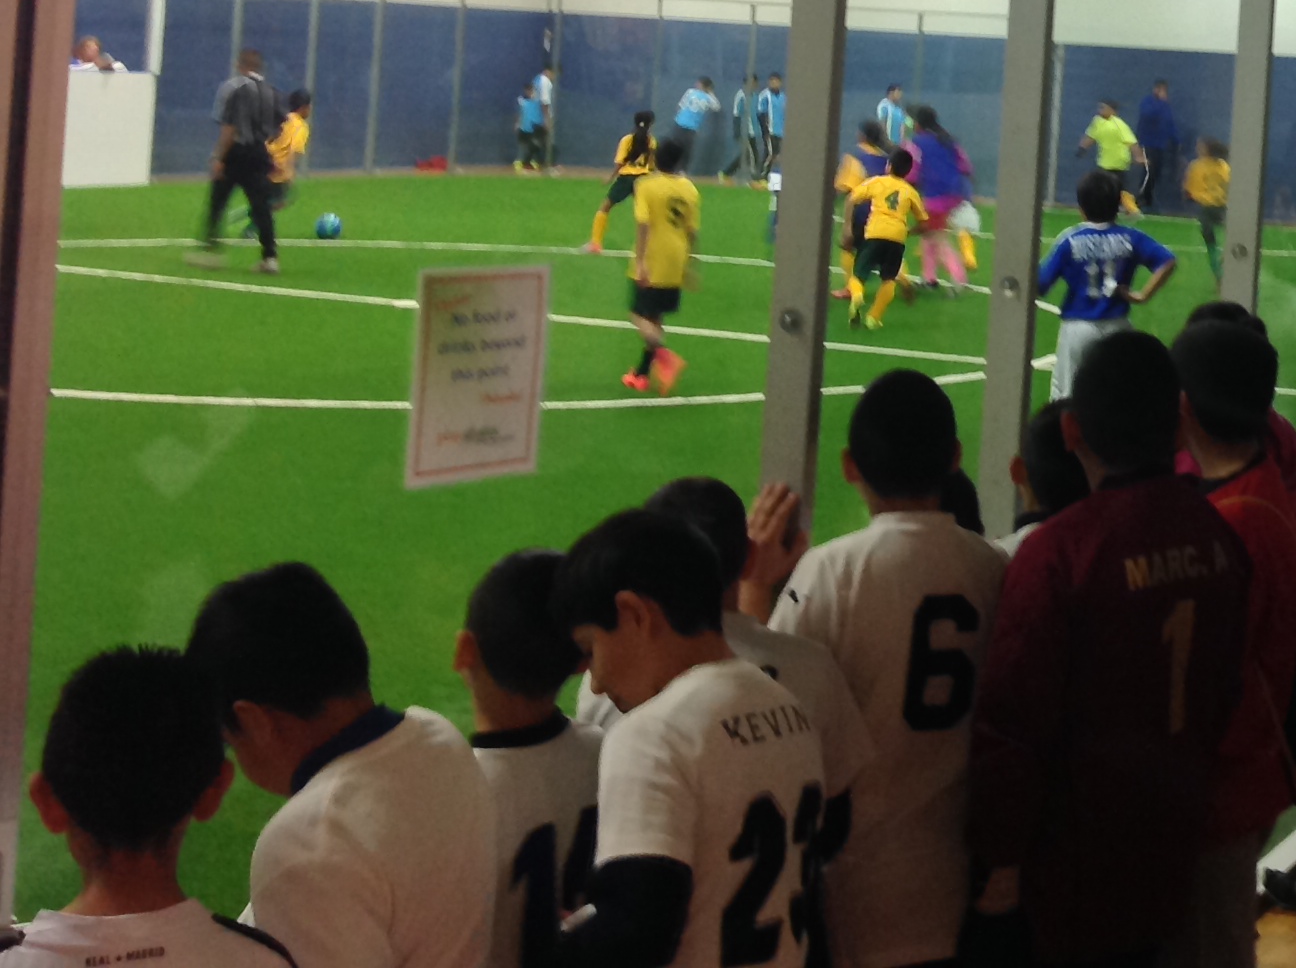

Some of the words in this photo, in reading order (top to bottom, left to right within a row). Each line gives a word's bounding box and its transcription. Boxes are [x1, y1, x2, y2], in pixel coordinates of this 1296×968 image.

[720, 703, 812, 748] KEVIN
[902, 593, 980, 732] 6
[1161, 598, 1196, 736] 1
